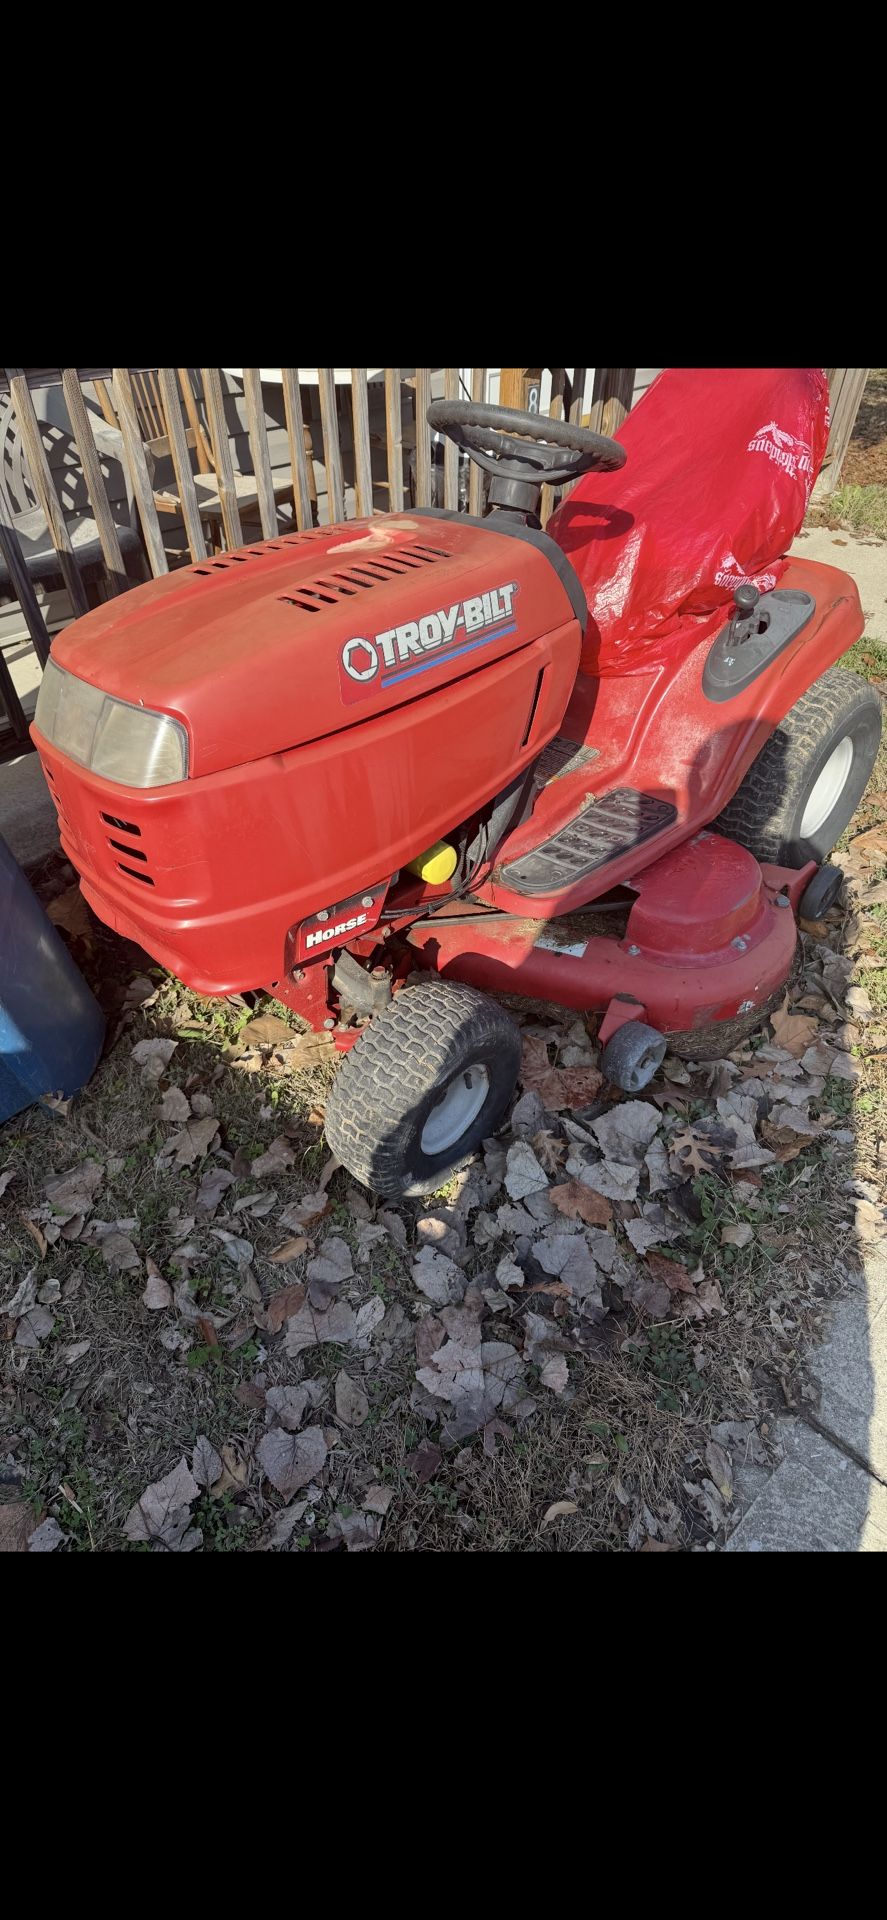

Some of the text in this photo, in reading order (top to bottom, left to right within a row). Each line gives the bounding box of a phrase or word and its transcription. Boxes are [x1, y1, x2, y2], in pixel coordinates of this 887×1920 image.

[529, 388, 538, 414] 8
[375, 583, 514, 667] TROY-BILT
[306, 913, 367, 949] HORSE
